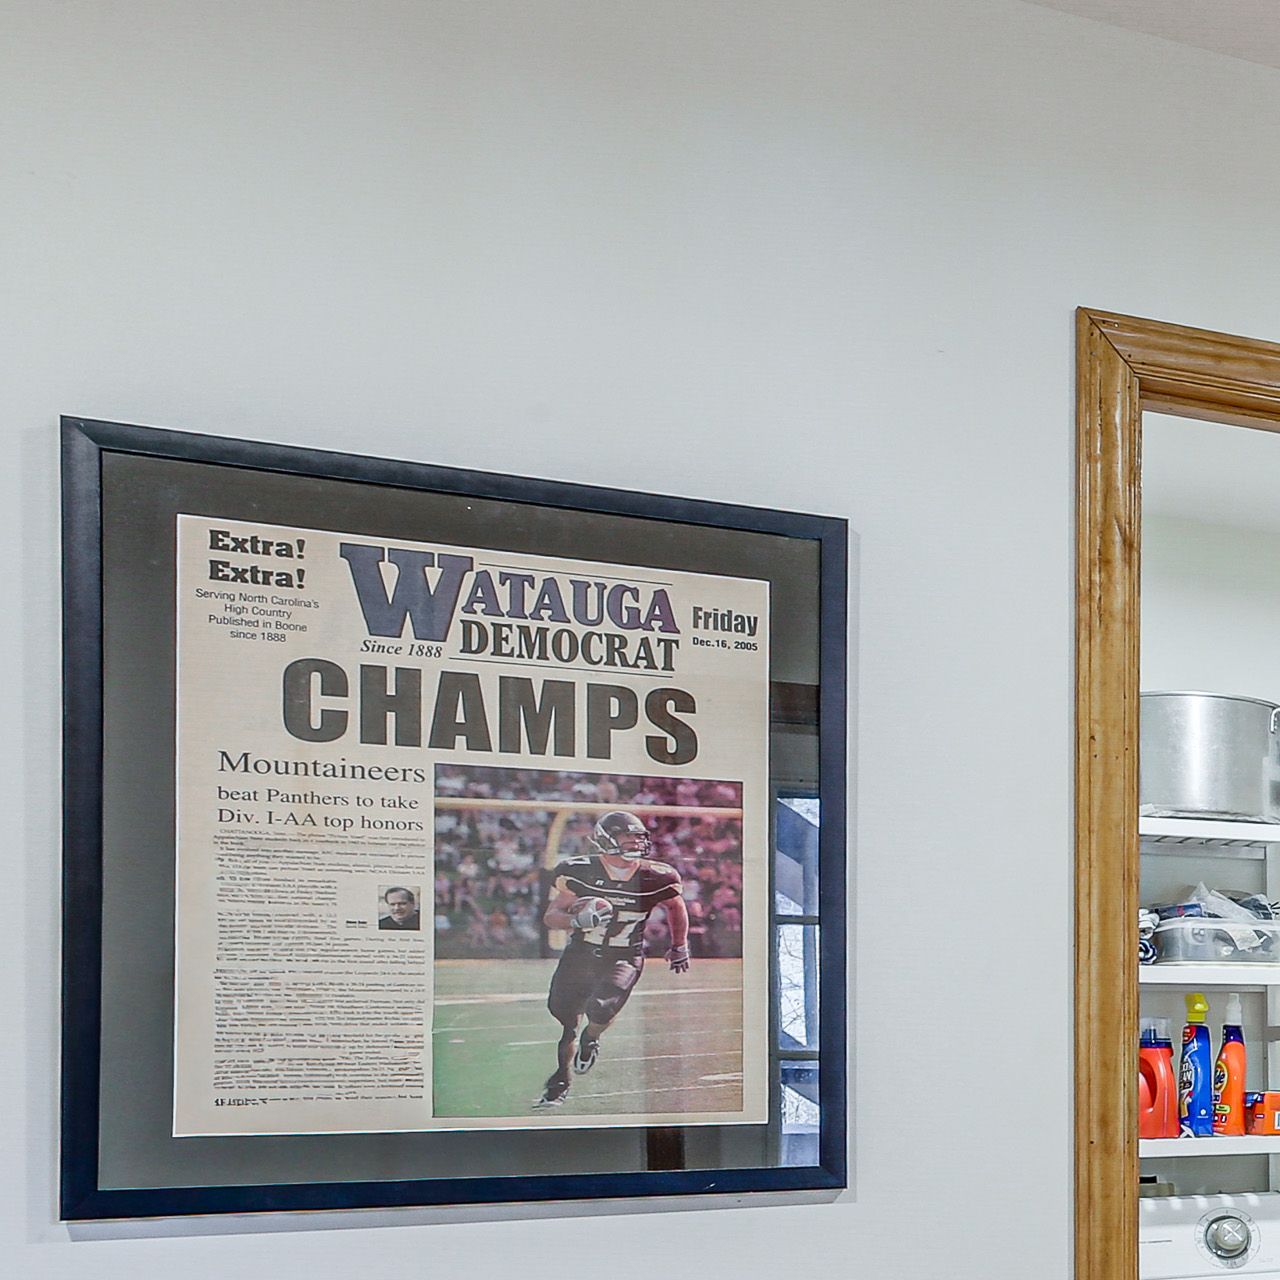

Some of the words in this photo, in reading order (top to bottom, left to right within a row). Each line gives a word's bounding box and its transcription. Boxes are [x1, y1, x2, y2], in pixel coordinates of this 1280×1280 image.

[209, 529, 305, 559] Extra!
[209, 560, 305, 589] Extra!
[195, 588, 235, 601] Serving
[240, 593, 268, 604] North
[271, 596, 320, 608] Carolina's
[340, 542, 681, 642] WATAUGA
[208, 614, 259, 627] Published
[263, 619, 272, 628] in
[275, 621, 307, 632] Boone
[224, 604, 248, 615] High
[252, 606, 292, 620] Country
[693, 606, 758, 636] Friday
[230, 630, 257, 640] since
[261, 632, 286, 642] 1888
[460, 619, 679, 672] DEMOCRAT
[734, 641, 758, 651] 2005
[360, 640, 402, 655] Since
[408, 644, 443, 658] 1888
[283, 657, 698, 766] CHAMPS
[218, 750, 425, 783] Mountaineers
[217, 786, 259, 802] beat
[266, 788, 350, 806] Panthers
[356, 795, 373, 808] to
[381, 795, 419, 810] take
[218, 808, 260, 824] Div.
[267, 811, 317, 827] I-AA
[324, 815, 354, 831] top
[361, 815, 424, 831] honors
